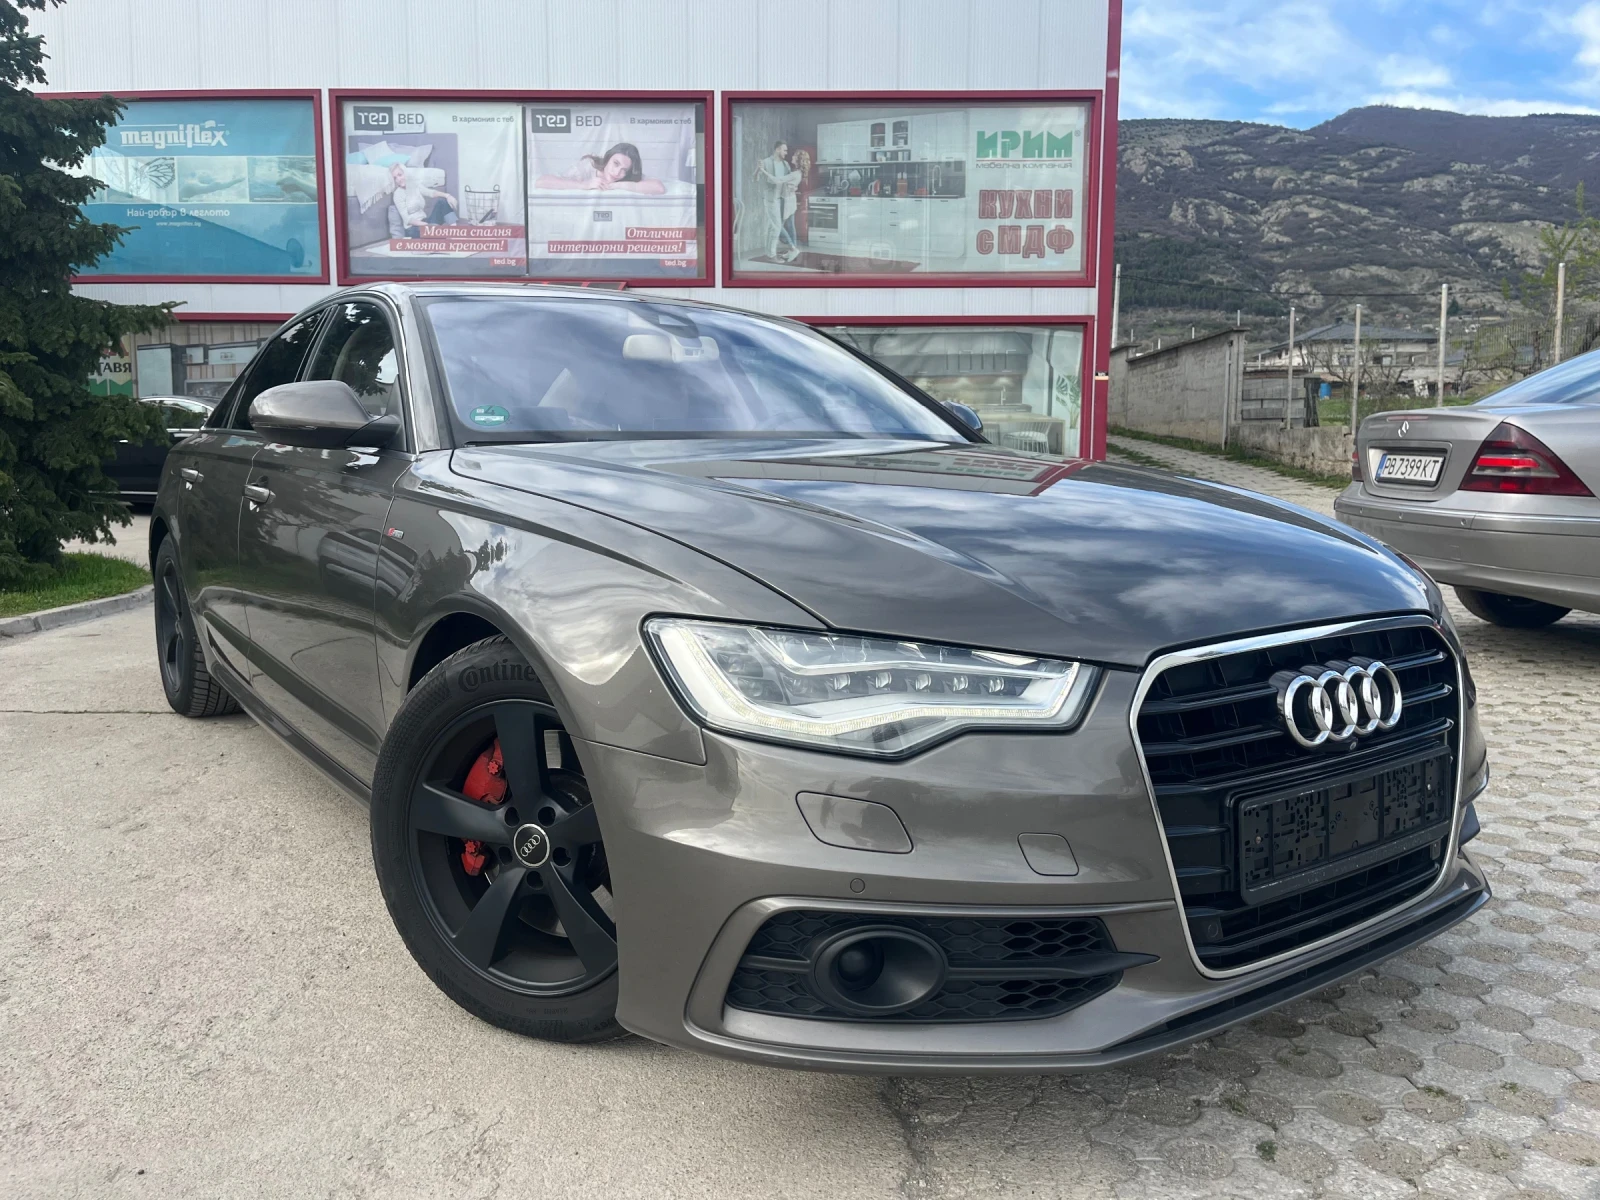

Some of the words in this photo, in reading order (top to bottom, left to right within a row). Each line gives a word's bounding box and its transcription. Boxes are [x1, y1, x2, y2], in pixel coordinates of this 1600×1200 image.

[398, 113, 425, 125] BED
[459, 116, 495, 124] хармония
[502, 115, 514, 123] теб
[575, 115, 603, 127] BED
[636, 118, 673, 126] хармония
[679, 117, 692, 125] теб
[120, 121, 228, 149] magniflex
[976, 130, 1073, 158] ИРИМ
[979, 189, 1073, 219] КУХНИ
[127, 208, 177, 218] Най-добър
[423, 225, 467, 236] Моята
[470, 228, 512, 236] спалня
[627, 227, 683, 238] Отлични
[395, 242, 403, 250] е
[404, 242, 446, 250] моята
[449, 240, 504, 252] крепост!
[549, 243, 624, 254] интериорни
[627, 241, 682, 254] решения!
[494, 258, 516, 266] ted.bg
[664, 259, 687, 267] ted.bg
[458, 658, 541, 693] Contine
